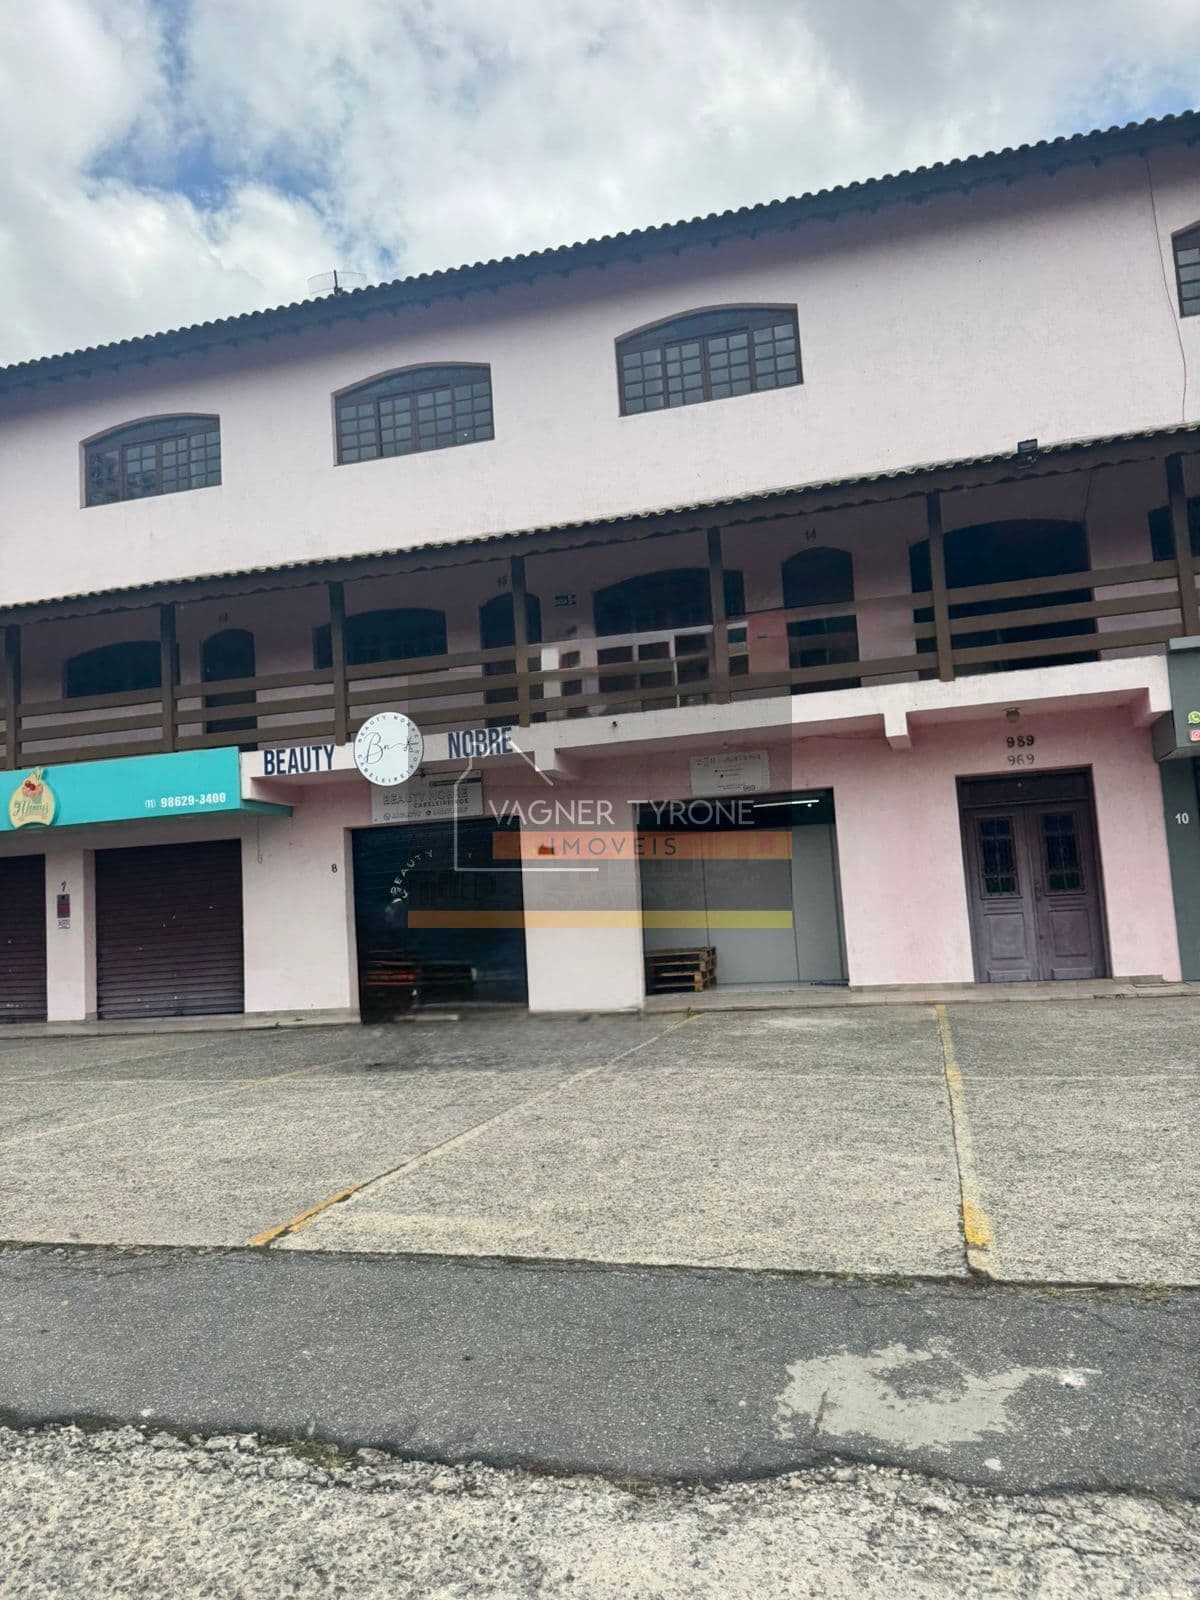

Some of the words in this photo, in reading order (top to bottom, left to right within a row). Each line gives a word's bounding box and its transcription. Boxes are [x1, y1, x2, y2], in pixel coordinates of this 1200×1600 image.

[448, 727, 513, 758] NOBRE
[1006, 735, 1034, 748] 989
[263, 744, 335, 776] BEAUTY
[1175, 812, 1189, 825] 10
[331, 863, 338, 873] 8
